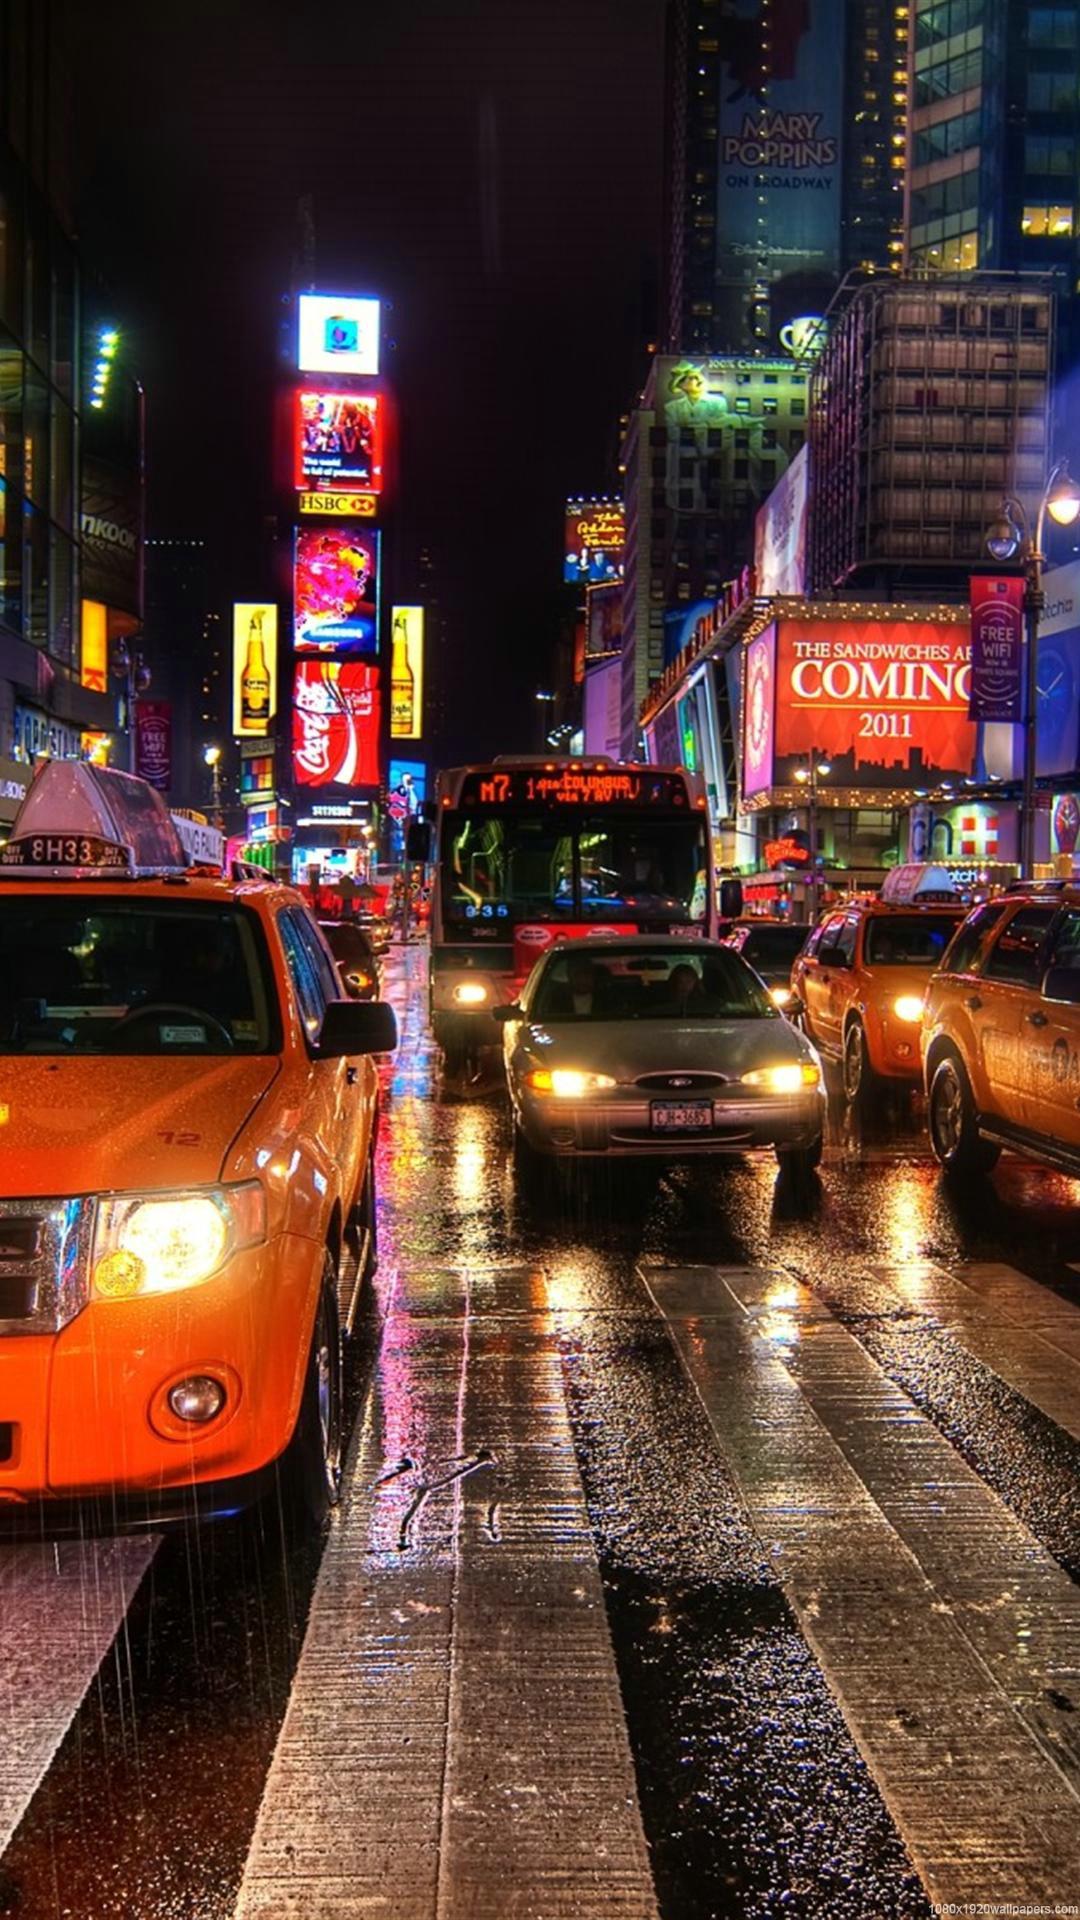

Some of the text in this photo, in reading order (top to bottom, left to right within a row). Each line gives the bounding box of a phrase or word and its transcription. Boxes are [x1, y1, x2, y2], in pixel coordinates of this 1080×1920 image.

[743, 113, 821, 140] MARY
[724, 138, 837, 168] POPPINS
[726, 175, 833, 190] ON BROADWAY
[301, 495, 348, 512] HSBC
[980, 625, 1015, 642] FREE
[793, 642, 830, 658] THE
[833, 643, 950, 661] SANDWICHES
[982, 642, 1012, 658] WIFI
[858, 712, 913, 738] 2011
[32, 838, 92, 864] 8H33
[157, 1130, 200, 1148] 12
